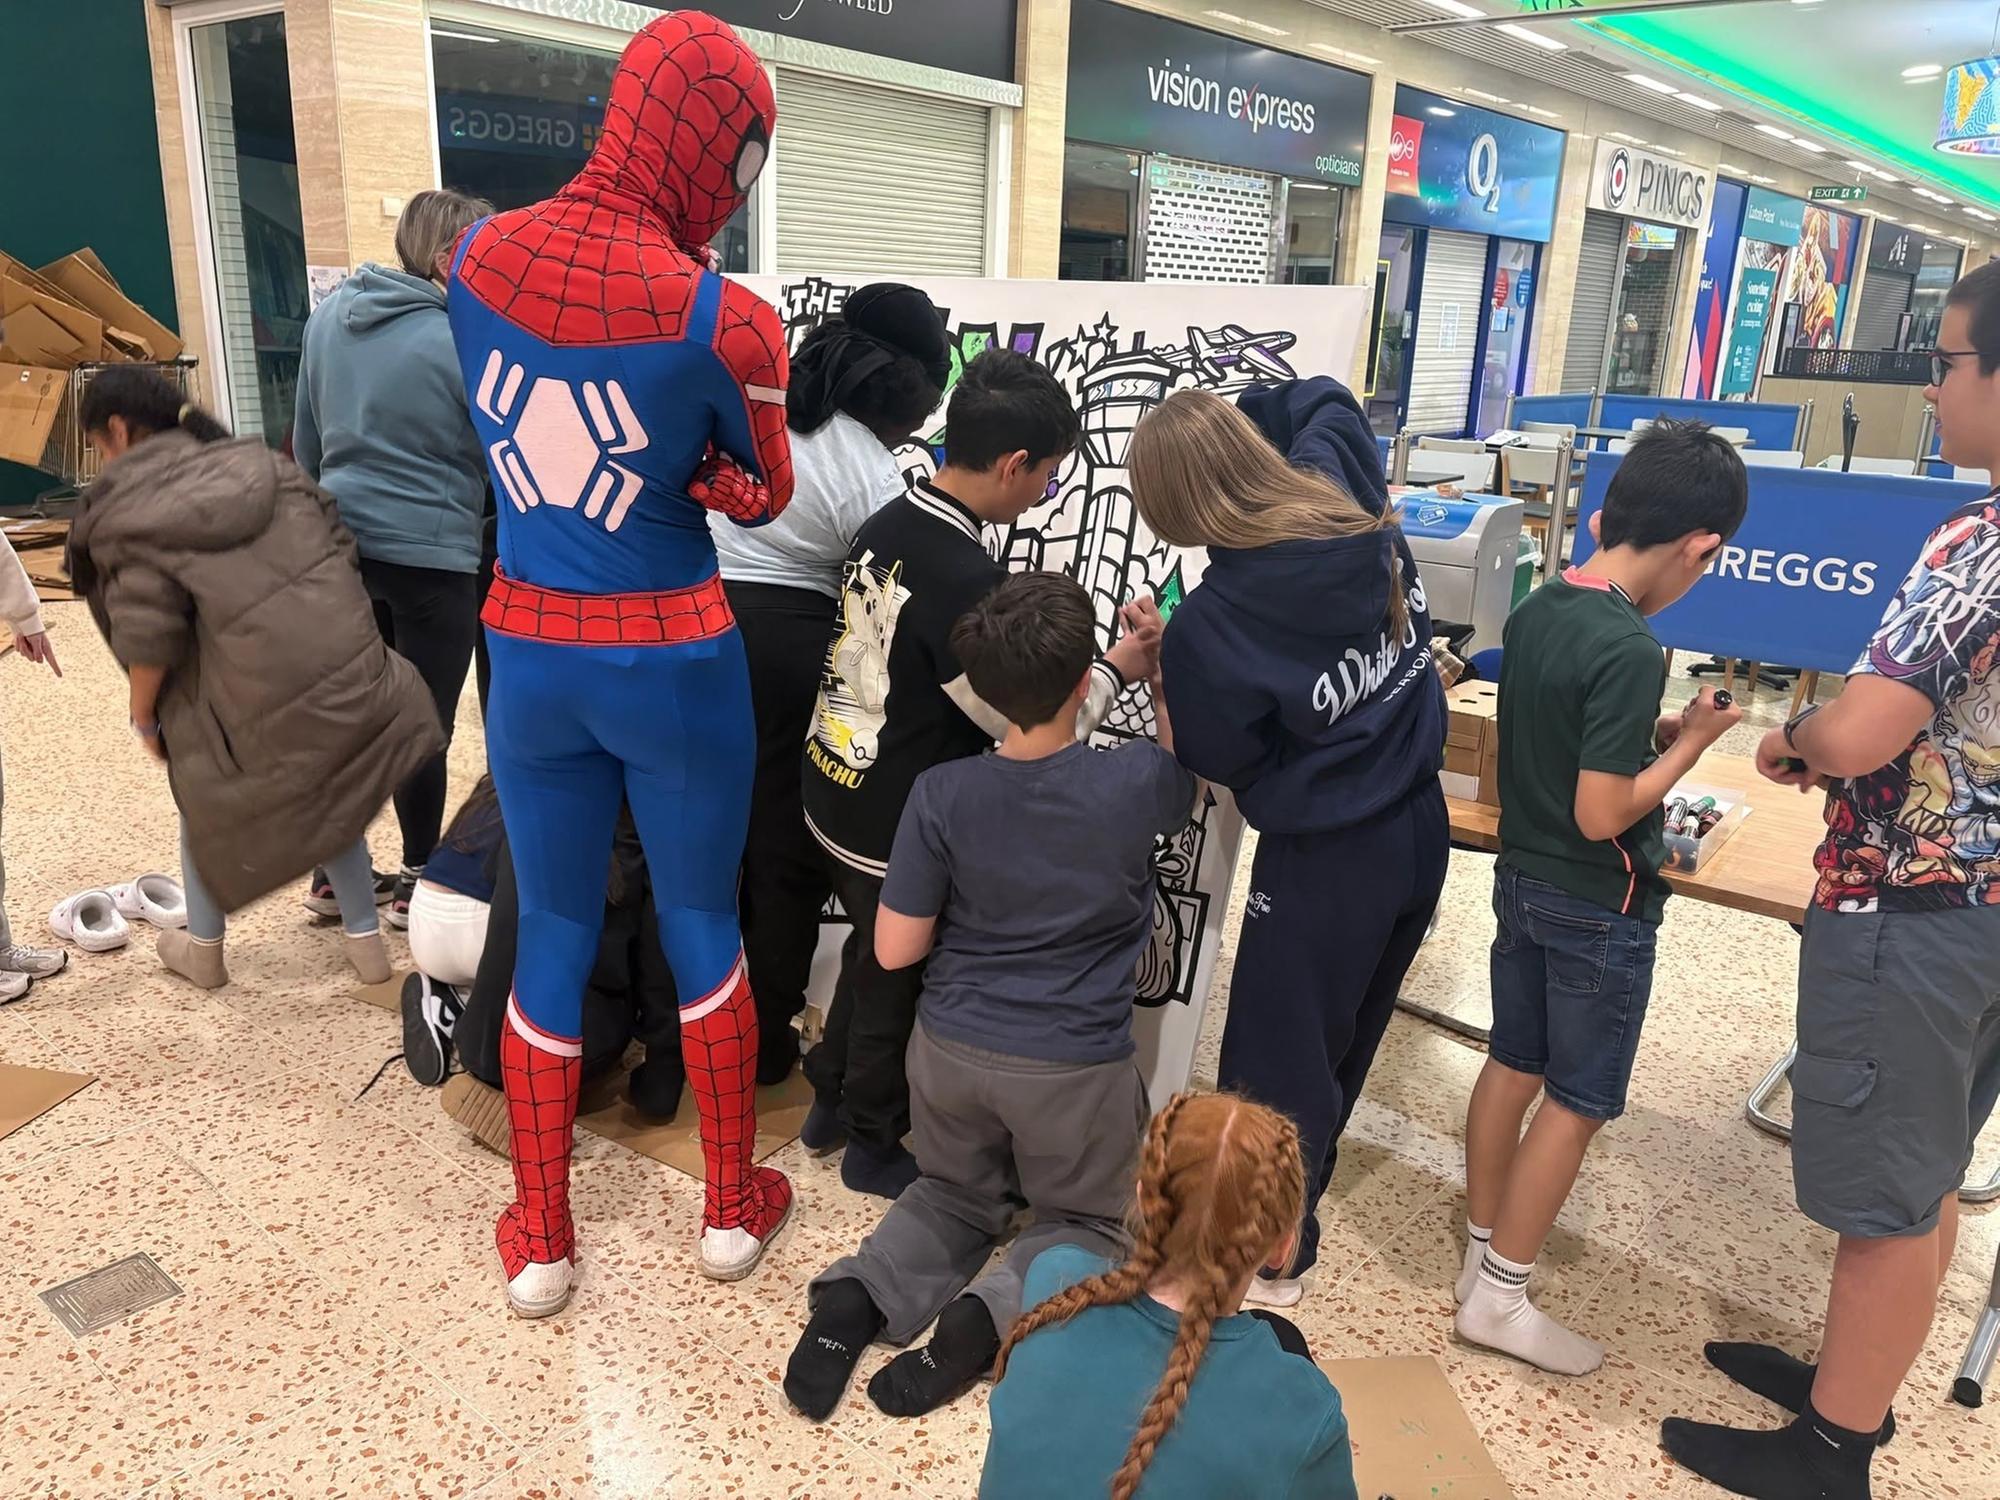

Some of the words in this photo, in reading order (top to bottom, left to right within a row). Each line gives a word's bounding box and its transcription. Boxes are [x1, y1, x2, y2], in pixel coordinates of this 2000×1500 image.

[1147, 58, 1221, 115] vision
[1227, 82, 1316, 134] express
[1315, 154, 1360, 177] opticians
[1814, 188, 1838, 198] EXIT
[1703, 545, 1878, 596] REGGS
[1312, 632, 1400, 727] White
[806, 739, 865, 789] PIKACHU
